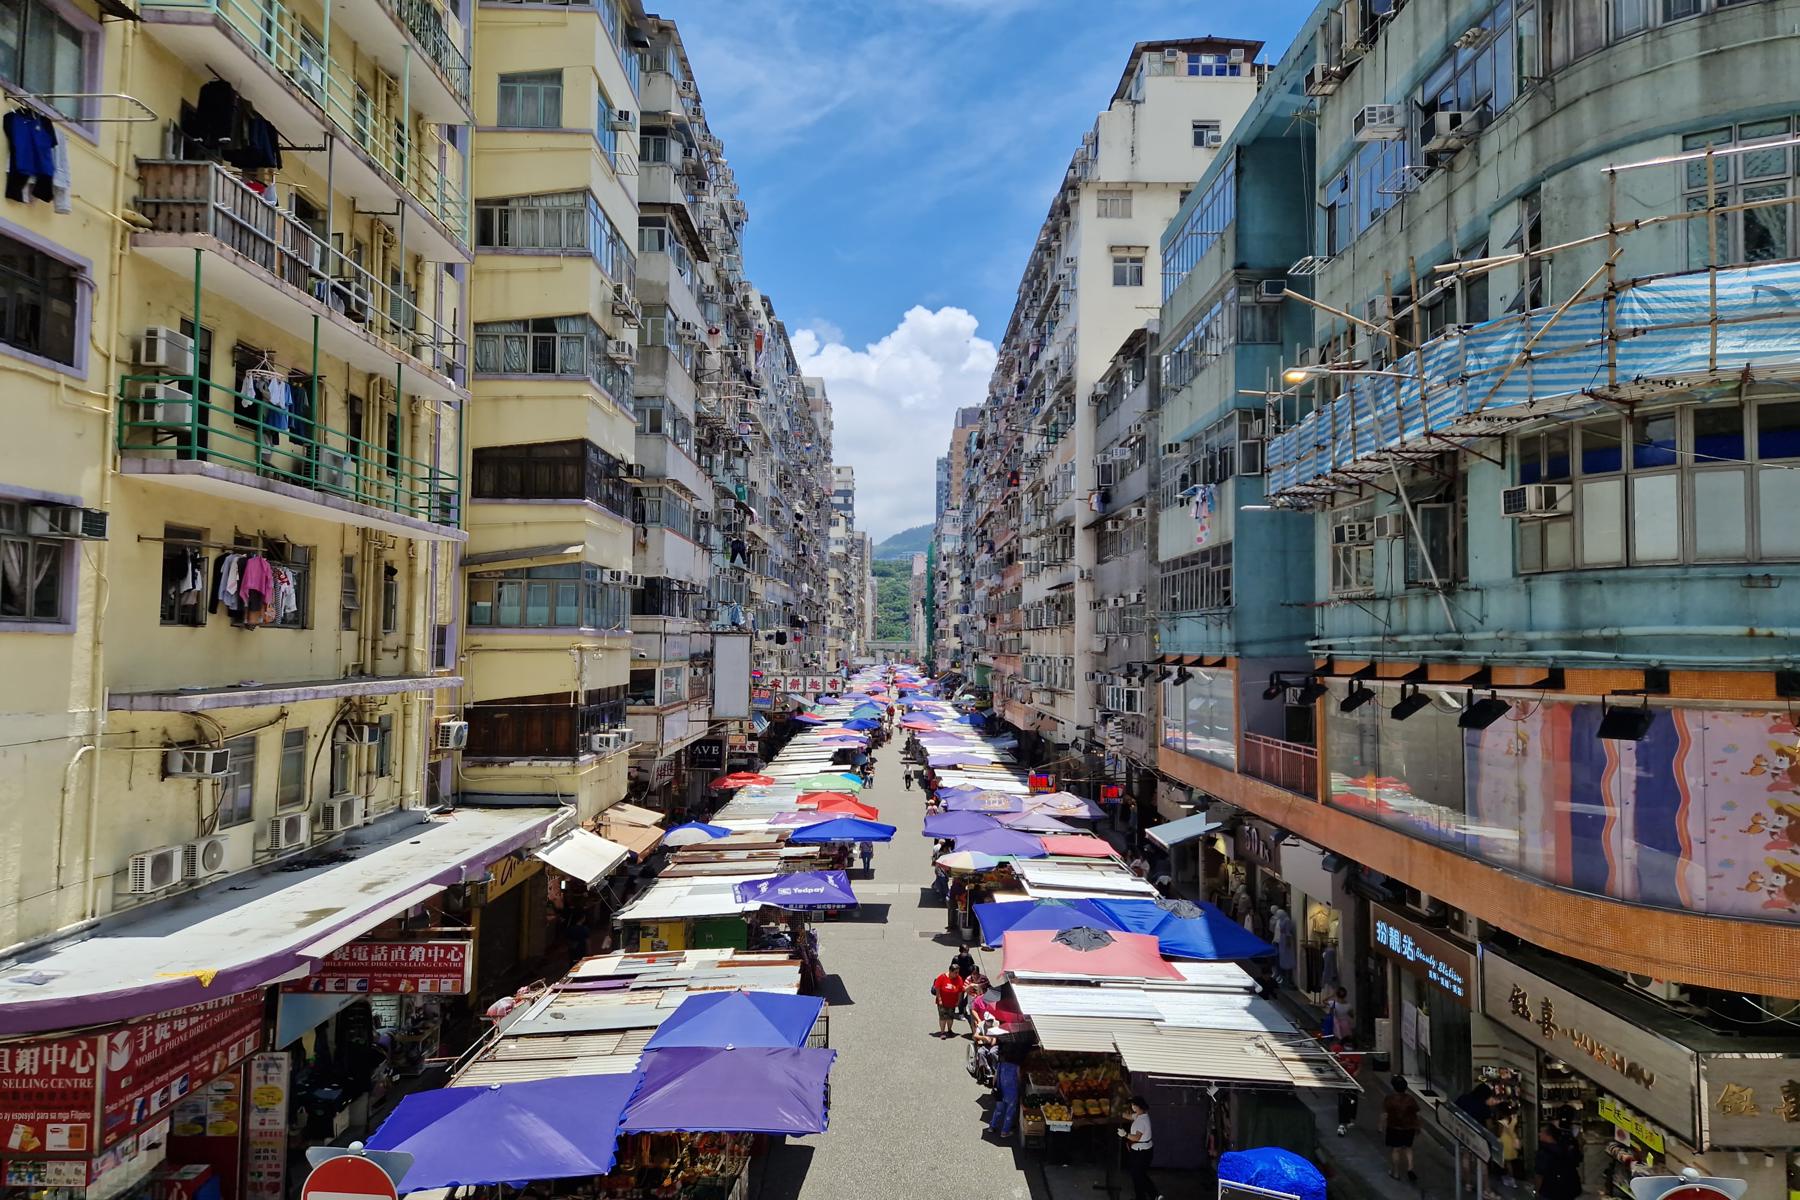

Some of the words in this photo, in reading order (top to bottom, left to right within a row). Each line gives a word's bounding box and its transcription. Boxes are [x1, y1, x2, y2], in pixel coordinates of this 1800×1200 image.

[793, 886, 824, 894] Yedpay
[2, 1078, 48, 1089] SELLING
[50, 1078, 94, 1089] CENTRE
